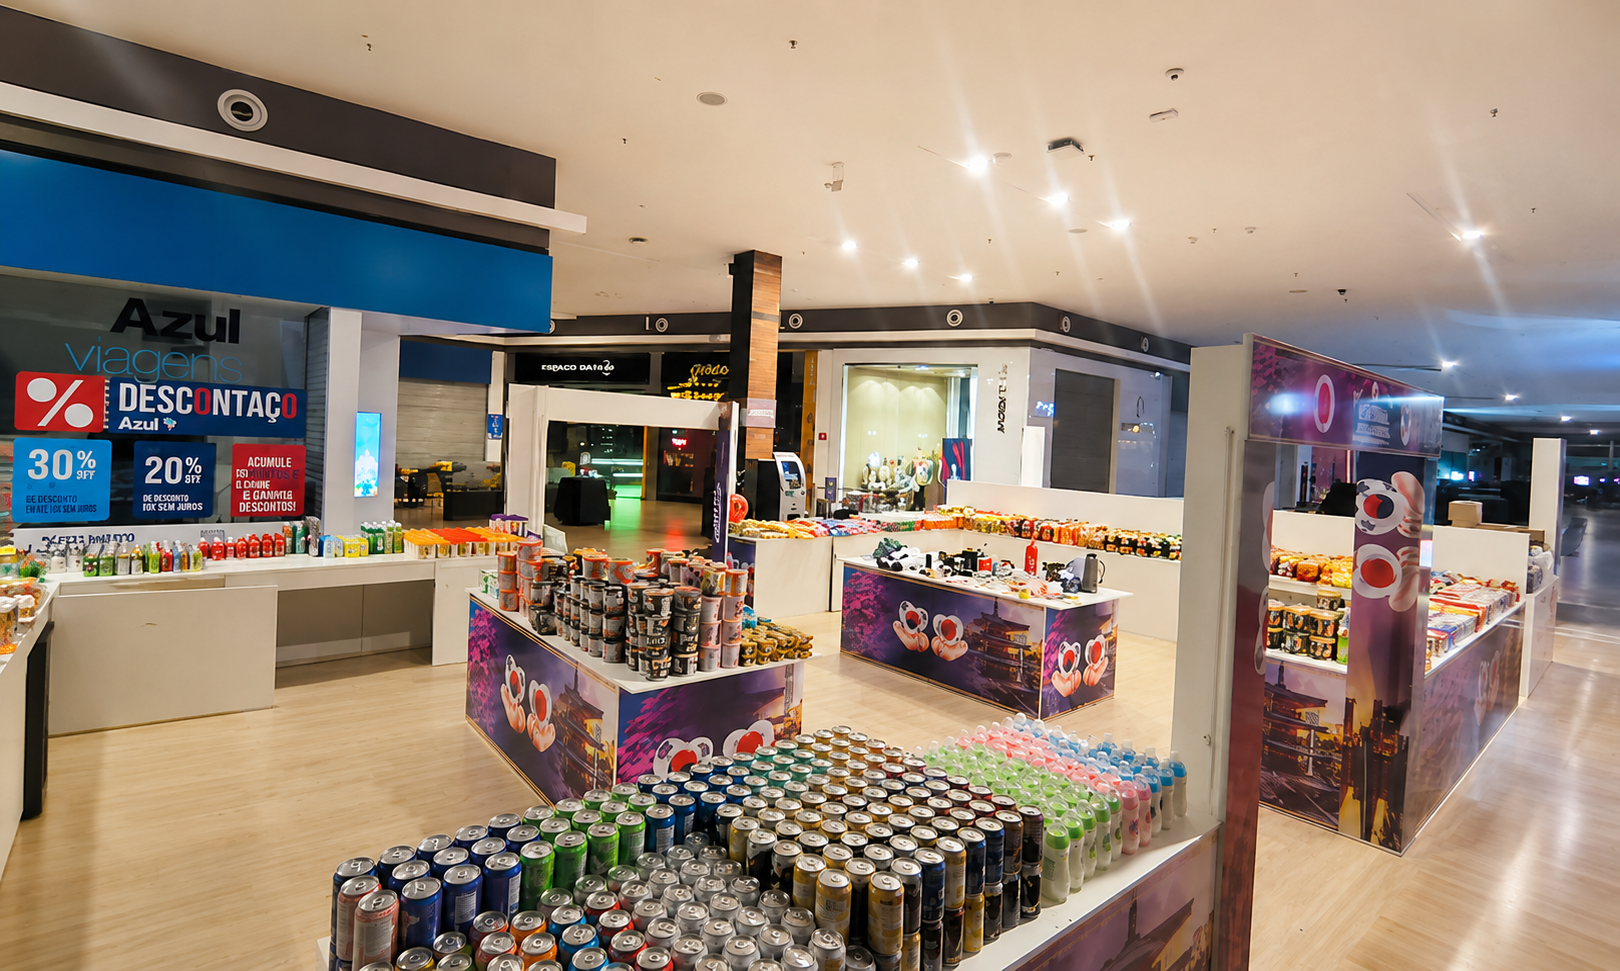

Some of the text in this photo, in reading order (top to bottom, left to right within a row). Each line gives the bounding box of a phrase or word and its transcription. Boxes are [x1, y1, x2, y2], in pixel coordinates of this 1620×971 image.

[110, 297, 242, 345] Azul
[65, 336, 243, 383] viagens
[118, 382, 298, 424] DESCONTAÇO
[118, 416, 159, 431] Azul
[247, 456, 293, 468] ACUMULE
